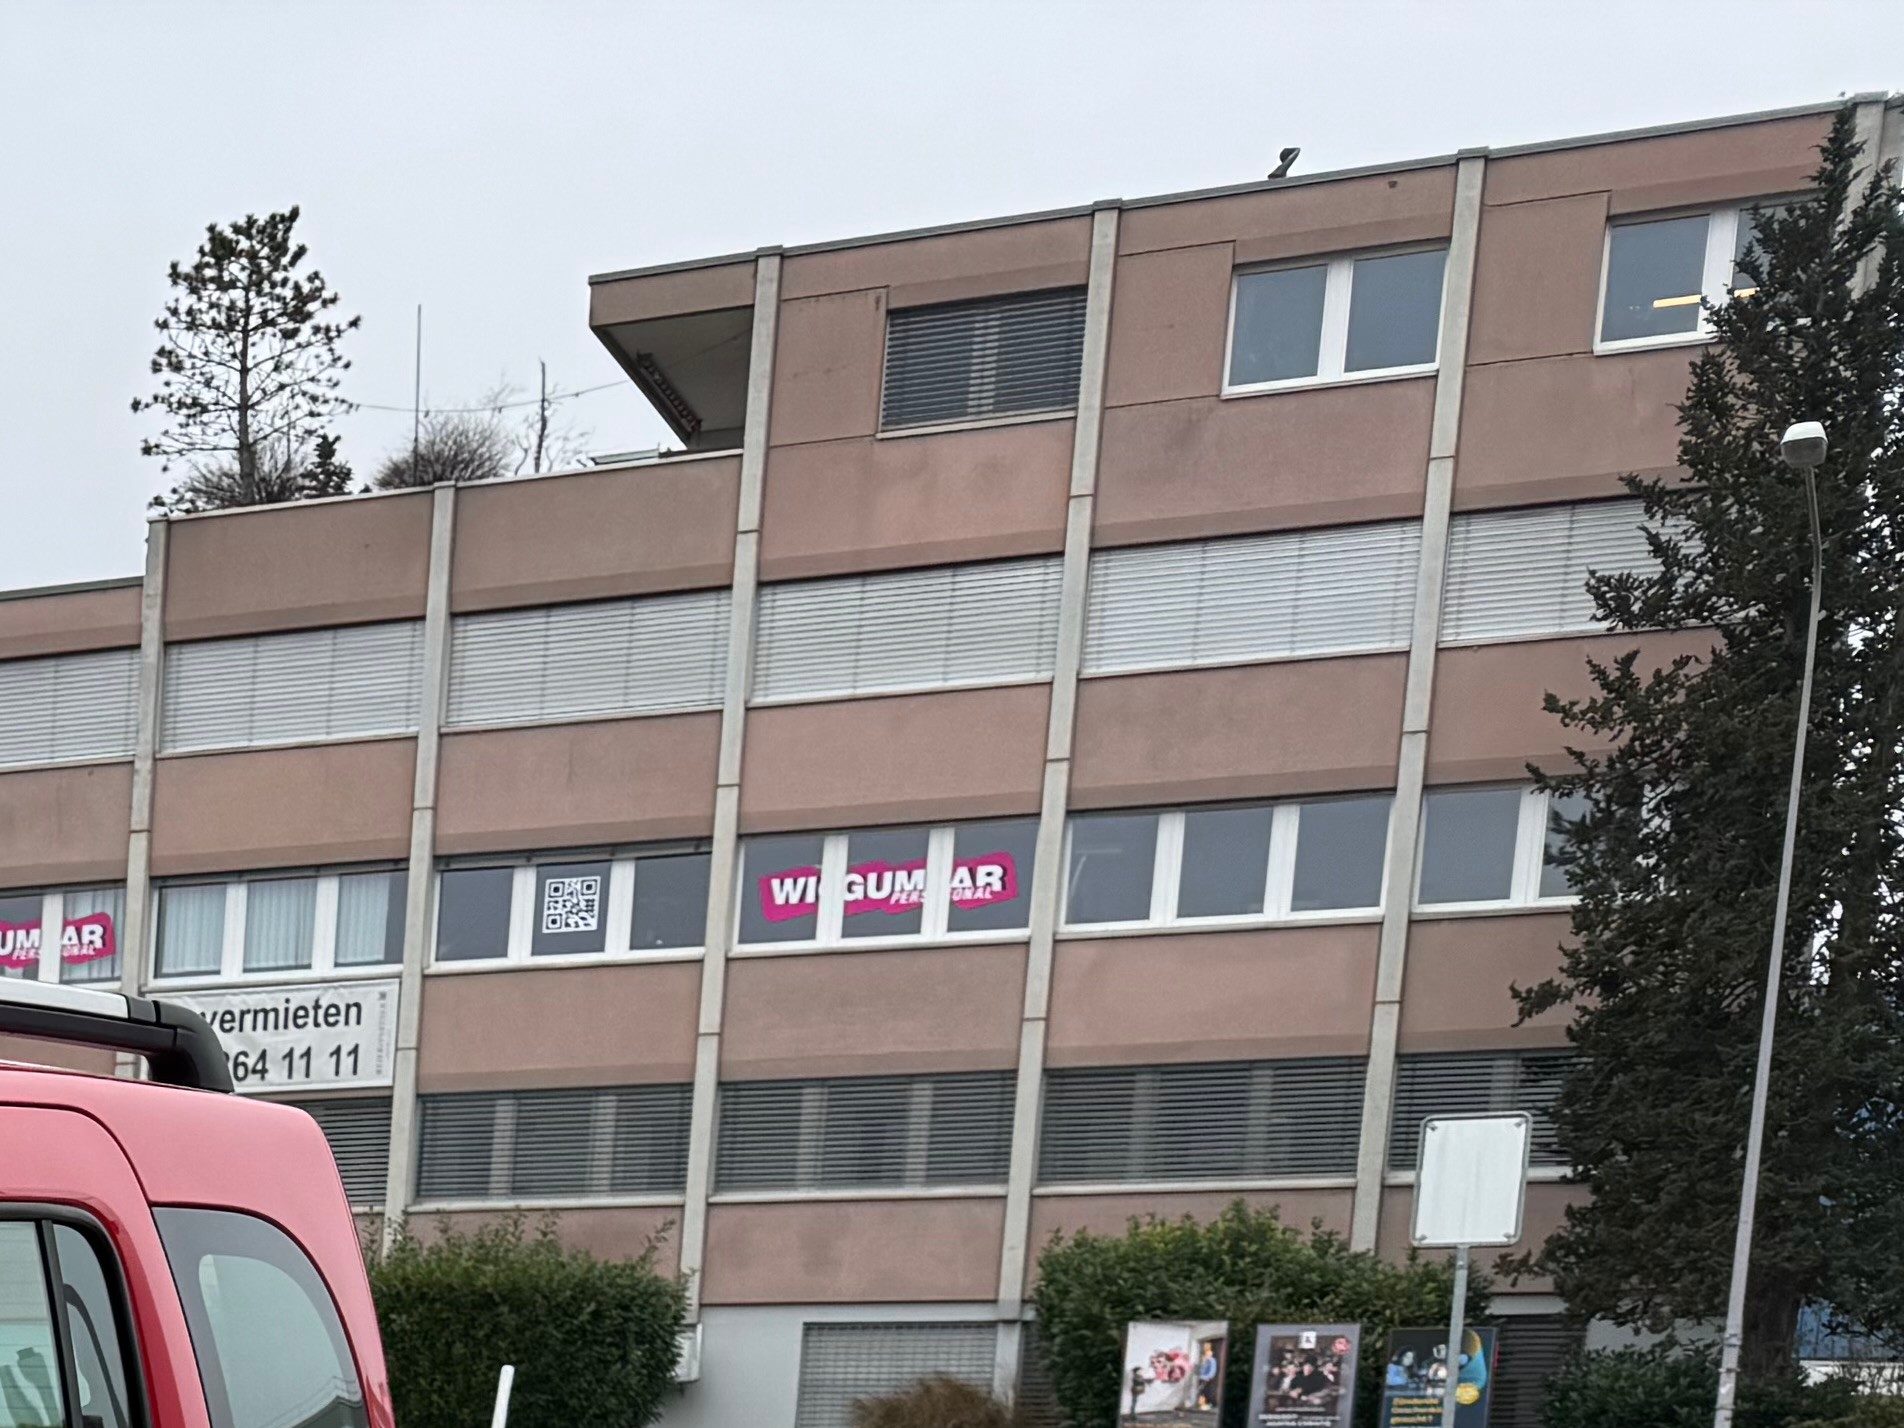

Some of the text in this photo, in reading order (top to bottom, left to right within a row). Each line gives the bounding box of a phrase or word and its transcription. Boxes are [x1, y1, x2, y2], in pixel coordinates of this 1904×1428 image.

[200, 996, 362, 1034] vermieten
[225, 1043, 360, 1082] 64 11 11
